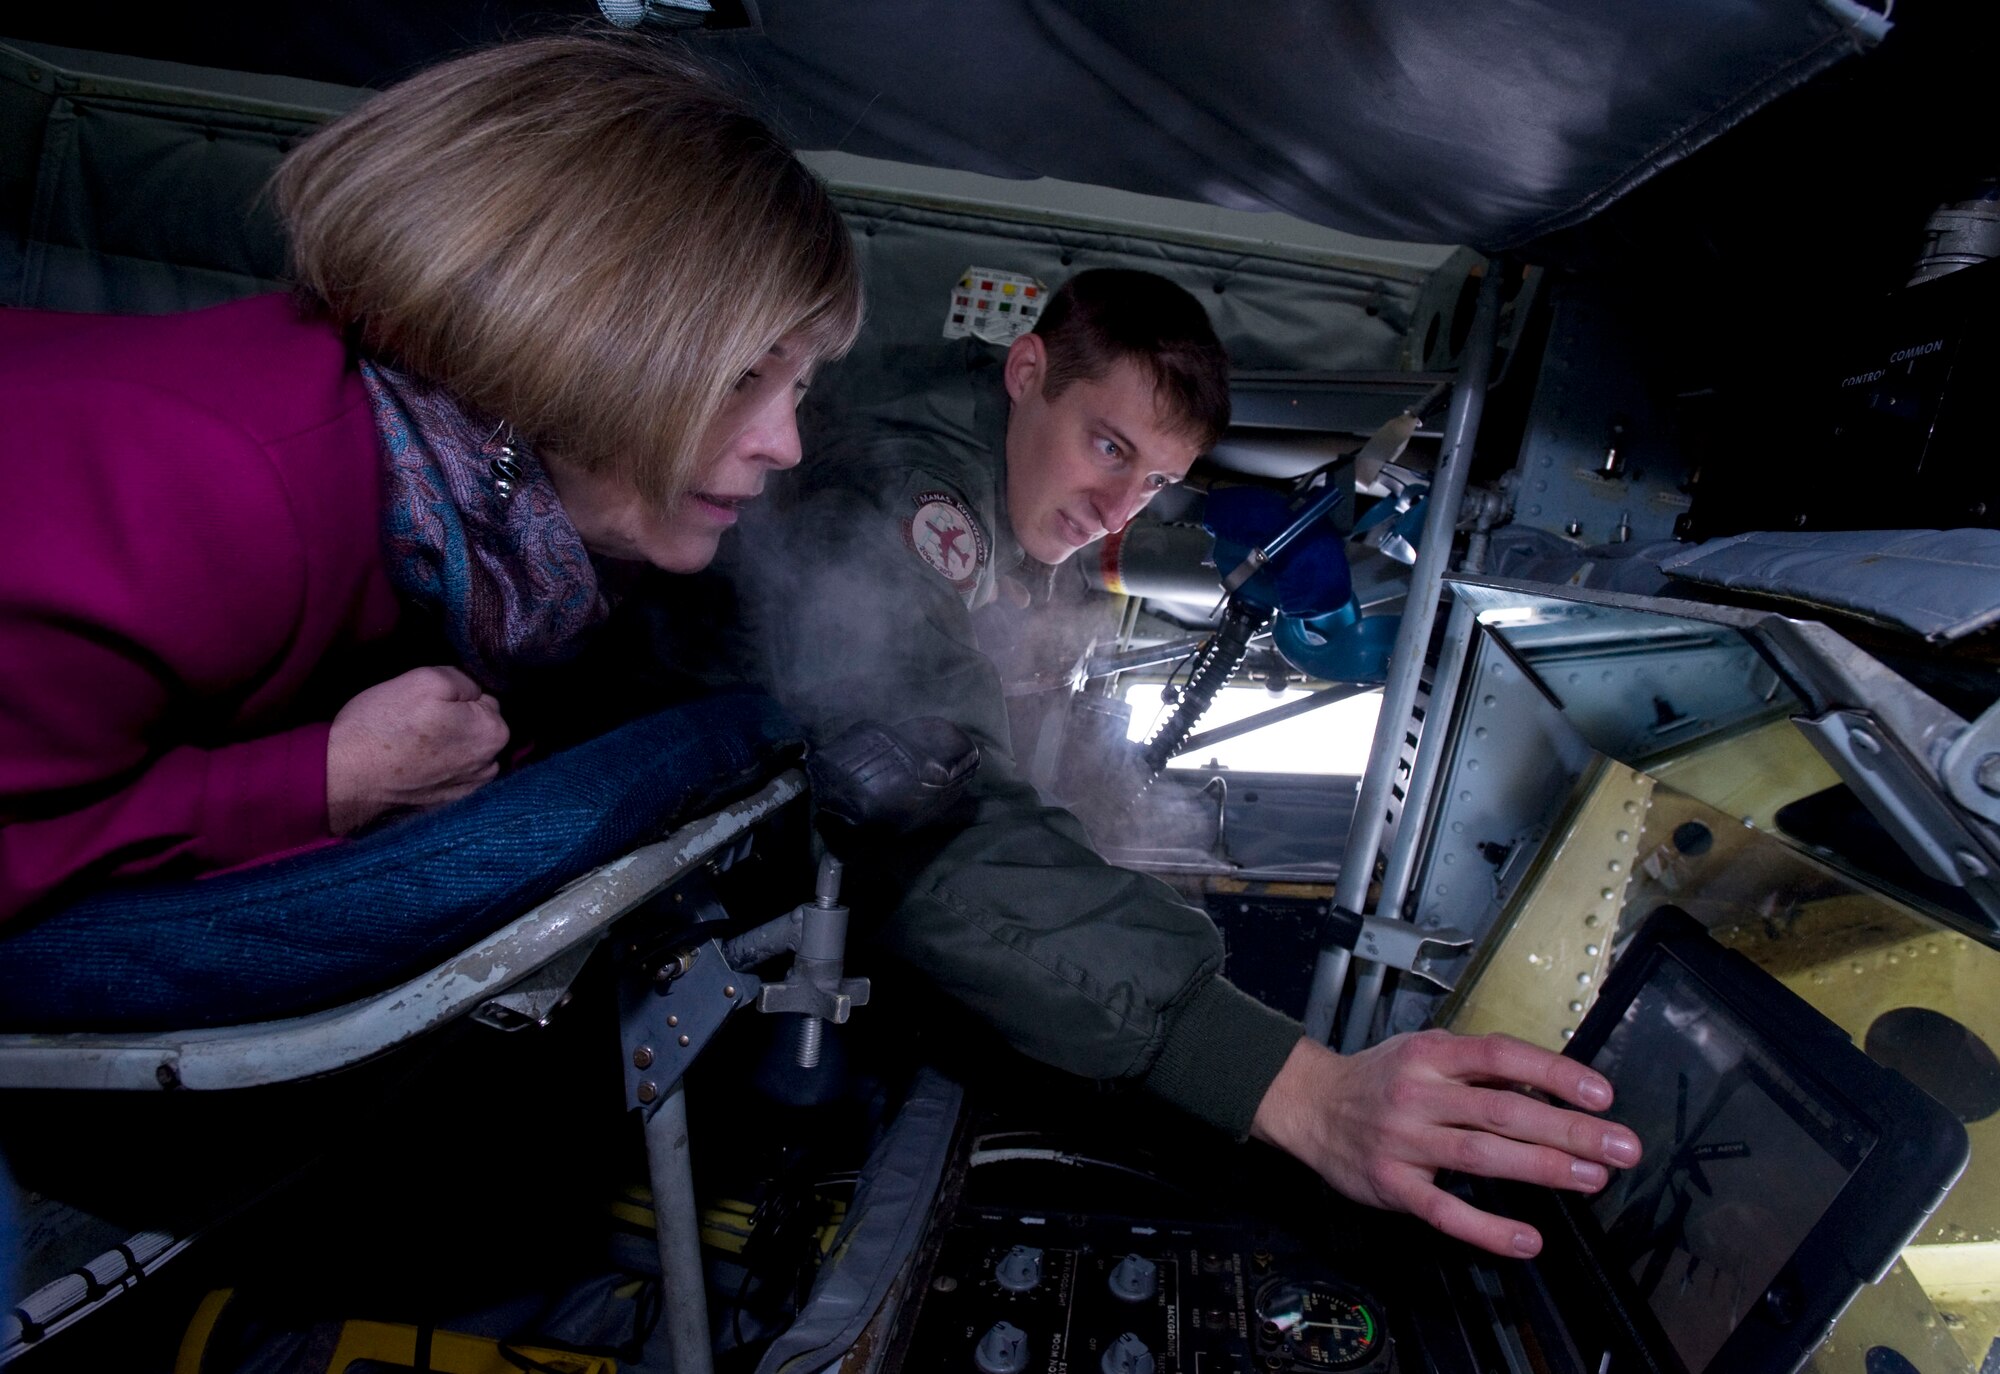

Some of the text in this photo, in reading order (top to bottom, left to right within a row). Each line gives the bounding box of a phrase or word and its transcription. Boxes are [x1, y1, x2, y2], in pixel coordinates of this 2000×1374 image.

[1889, 339, 1944, 364] COMMON
[1166, 1304, 1176, 1358] BACKGROUND
[1237, 1310, 1248, 1338] SYSTEM
[1050, 1333, 1062, 1358] BOOM
[1311, 1345, 1321, 1361] LEFT
